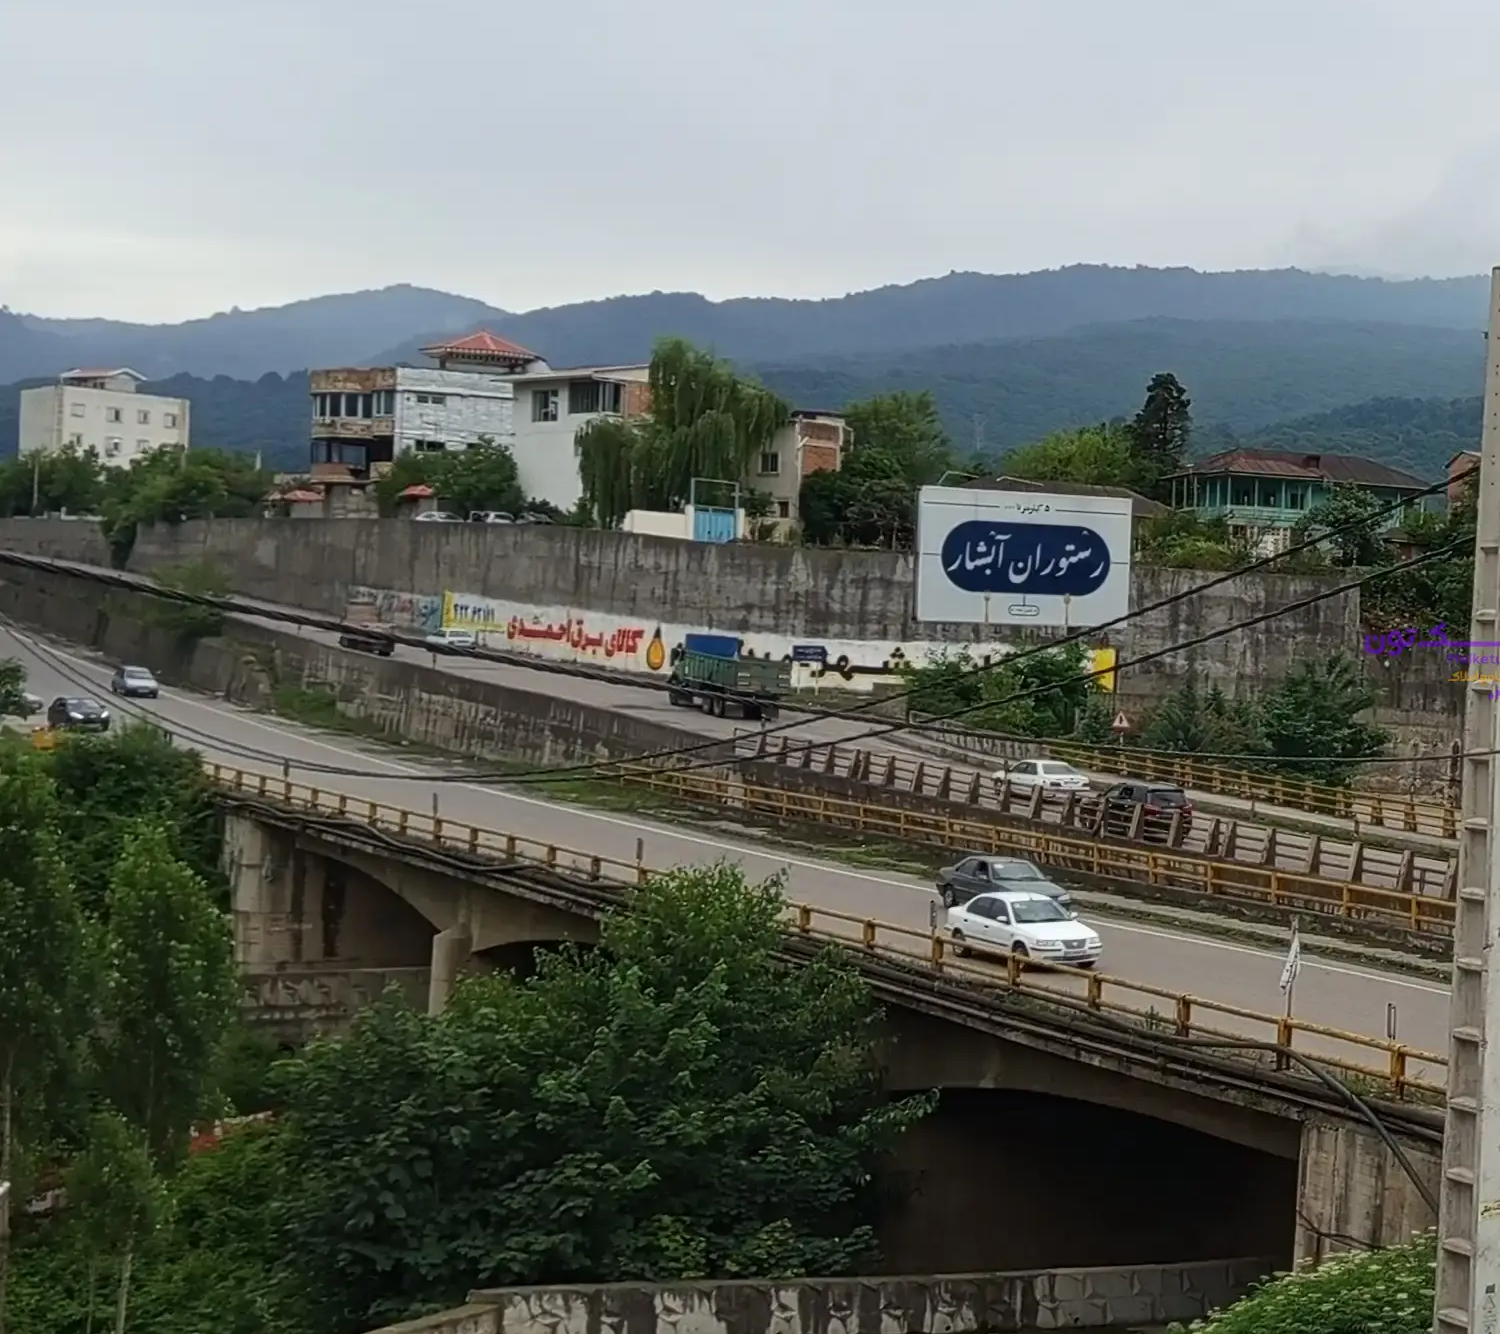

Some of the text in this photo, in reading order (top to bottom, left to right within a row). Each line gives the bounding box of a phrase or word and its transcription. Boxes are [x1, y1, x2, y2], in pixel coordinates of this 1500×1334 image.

[947, 531, 1105, 584] رستوران آبشار
[570, 618, 605, 656] برق
[604, 628, 645, 657] کالای
